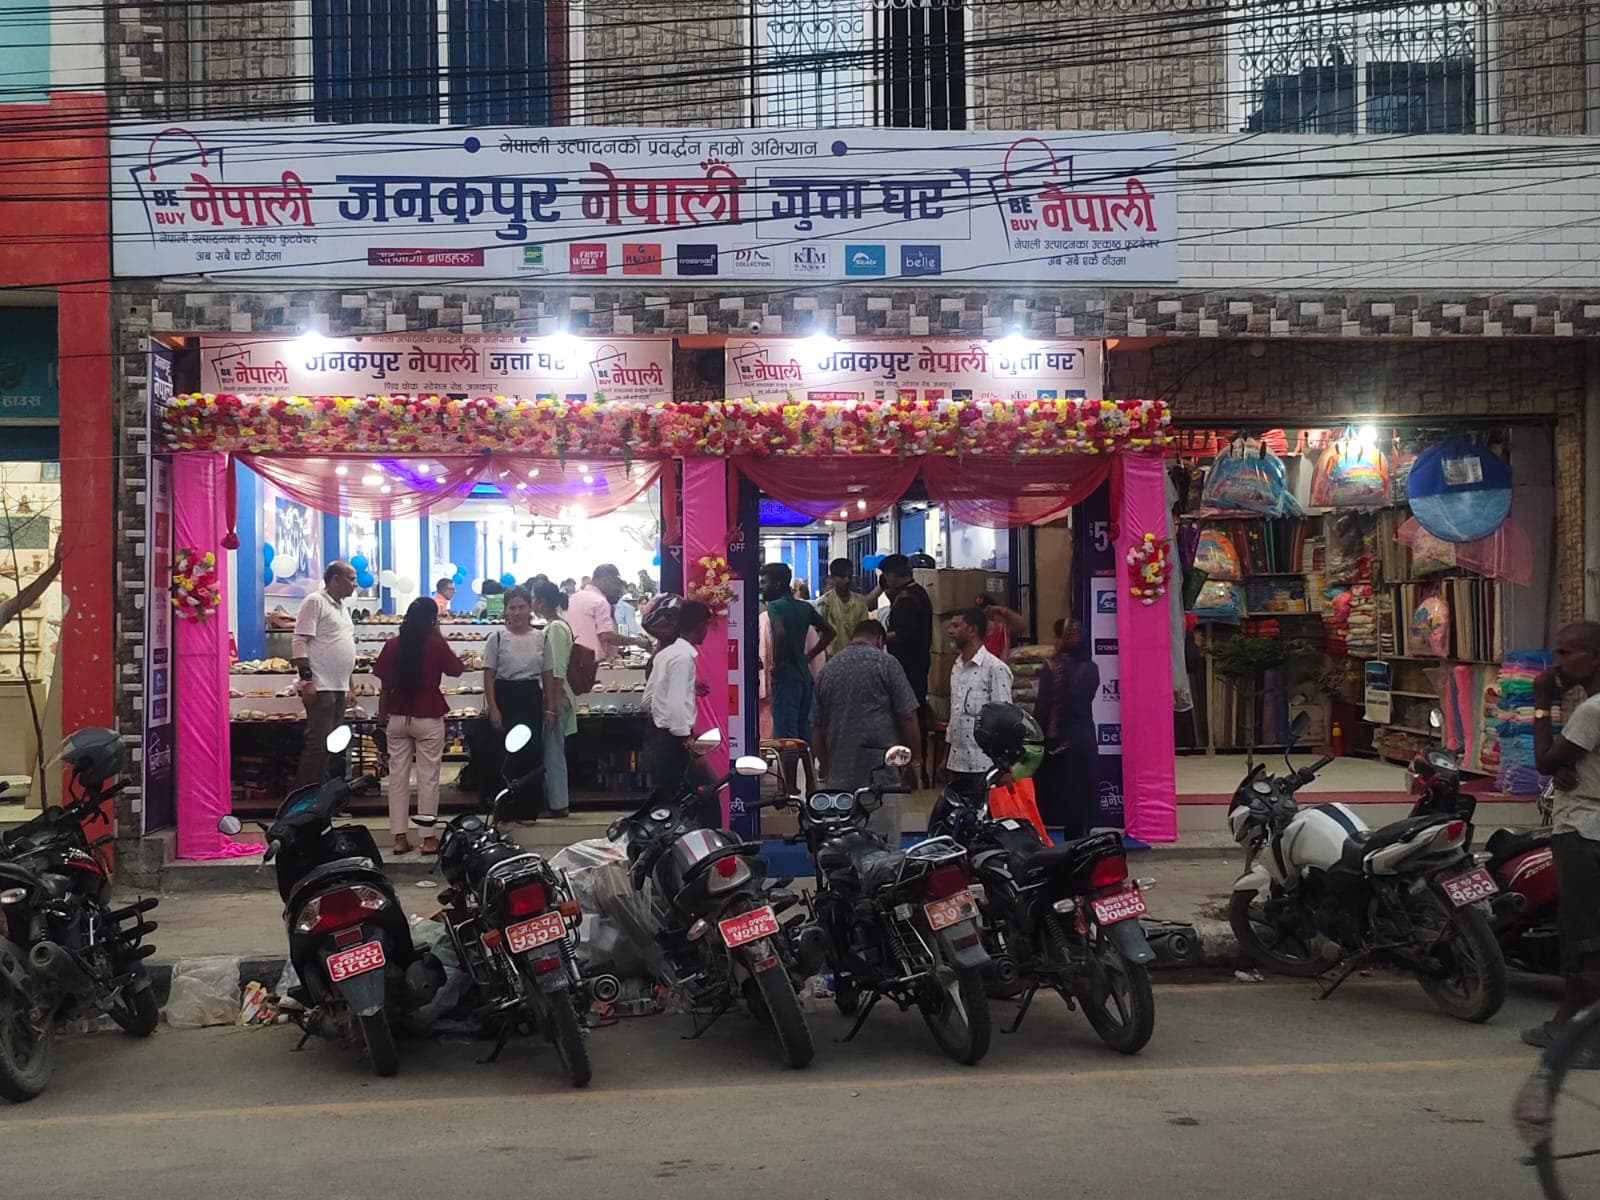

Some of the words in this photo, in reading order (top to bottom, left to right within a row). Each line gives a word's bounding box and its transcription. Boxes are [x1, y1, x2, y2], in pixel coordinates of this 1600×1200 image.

[499, 134, 549, 153] नेपाली
[708, 137, 744, 157] हाम्रो
[751, 138, 818, 156] अभियान
[152, 190, 179, 207] BE
[185, 170, 315, 227] नेपाली
[336, 174, 568, 240] जनकपुर
[579, 158, 747, 225] नेपाली
[769, 180, 870, 231] जुत्ता
[880, 180, 952, 220] घर
[1008, 198, 1033, 214] BE
[1037, 178, 1157, 232] नेपाली
[155, 212, 185, 225] BUY
[1010, 219, 1038, 231] BUY
[735, 250, 751, 261] DJ
[794, 247, 826, 264] KTM
[906, 254, 936, 267] belle
[408, 345, 480, 373] नेपाली
[490, 353, 533, 375] जुत्ता
[918, 345, 988, 373] नेपाली
[1046, 353, 1076, 370] घर
[235, 361, 288, 384] नेपाली
[598, 370, 609, 378] BE
[612, 362, 663, 386] नेपाली
[754, 359, 803, 381] नेपाली
[3, 396, 41, 407] हाउस
[729, 542, 745, 552] OFF
